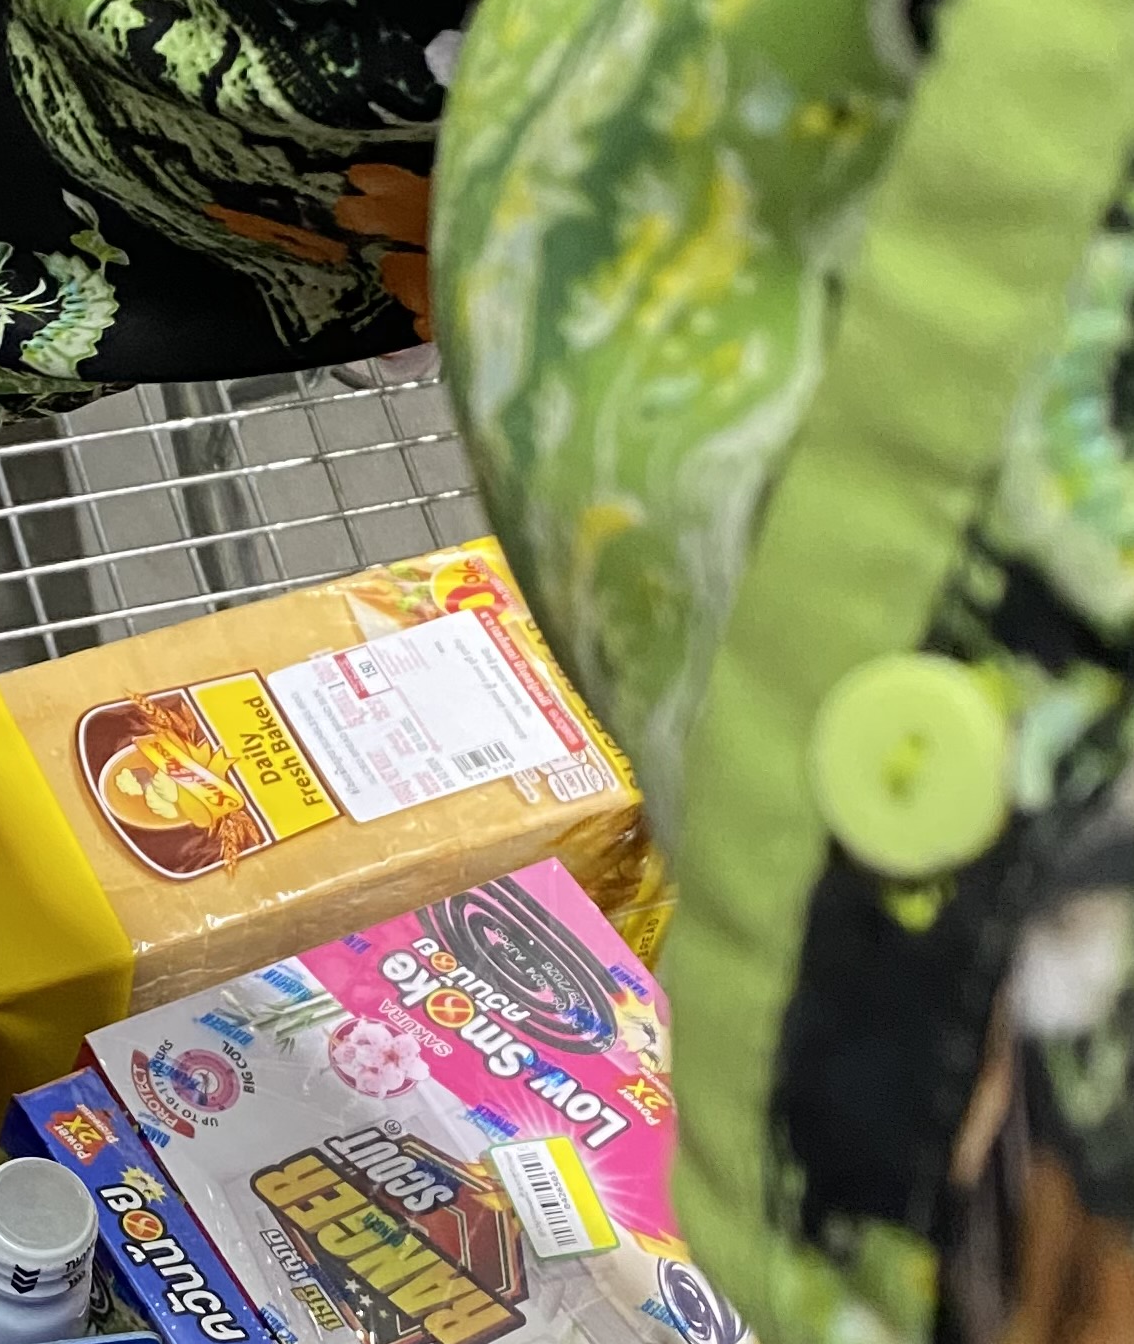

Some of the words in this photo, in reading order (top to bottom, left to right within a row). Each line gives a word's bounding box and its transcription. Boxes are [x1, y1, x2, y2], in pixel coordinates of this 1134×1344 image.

[243, 695, 291, 754] Baked
[239, 732, 283, 786] Daily
[281, 755, 325, 807] Fresh
[378, 998, 454, 1058] SAKURA
[222, 1039, 249, 1071] COIL
[133, 1063, 179, 1130] PROTECT
[241, 1069, 256, 1095] BIG
[626, 1077, 670, 1108] 2X
[75, 1103, 120, 1145] Protector
[180, 1107, 200, 1127] TO
[202, 1117, 220, 1129] UP
[616, 1087, 662, 1127] Power
[53, 1124, 92, 1160] Power
[63, 1114, 103, 1145] 2X
[336, 1128, 456, 1213] SCOUT
